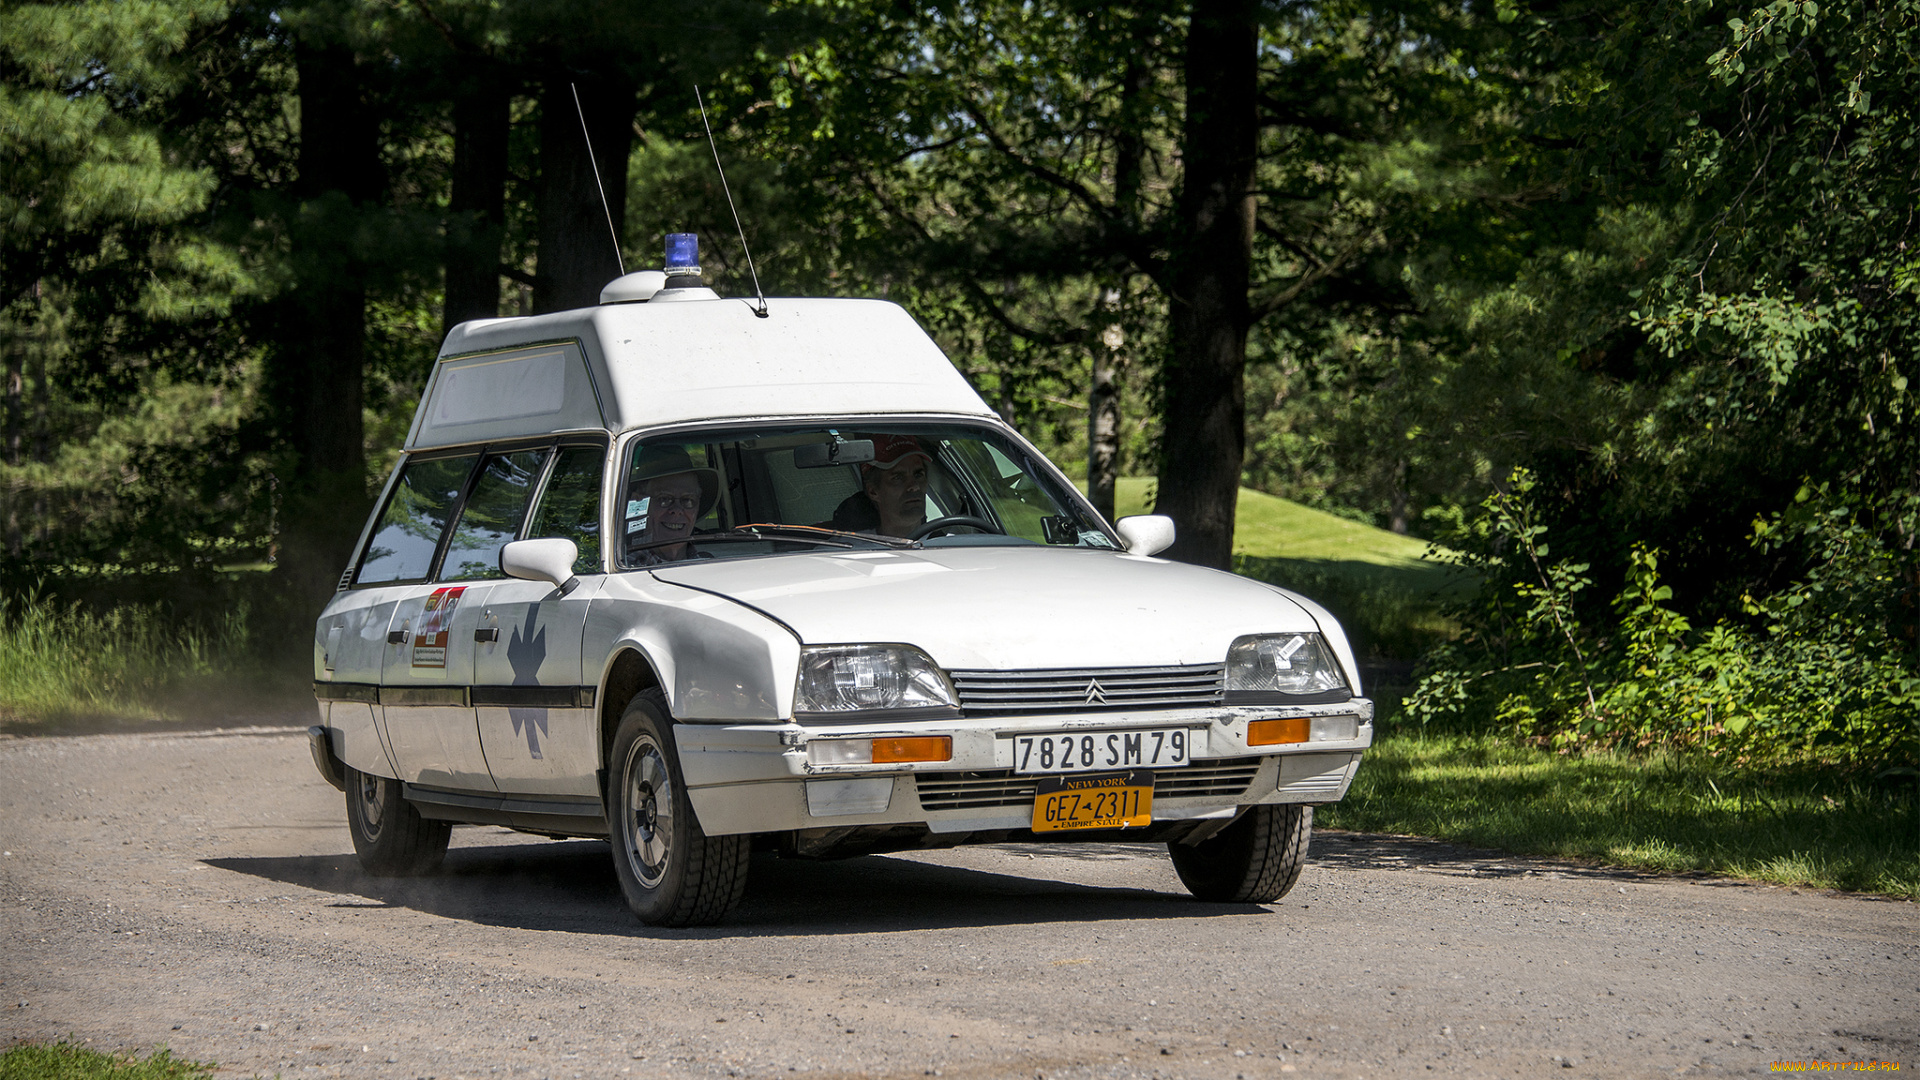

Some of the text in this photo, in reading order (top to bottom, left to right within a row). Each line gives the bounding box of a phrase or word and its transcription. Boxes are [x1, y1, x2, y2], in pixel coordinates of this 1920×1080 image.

[1019, 731, 1185, 771] 7828 SM 79
[1066, 777, 1127, 790] NEW YORK
[1061, 818, 1123, 829] EMPIRE STATE
